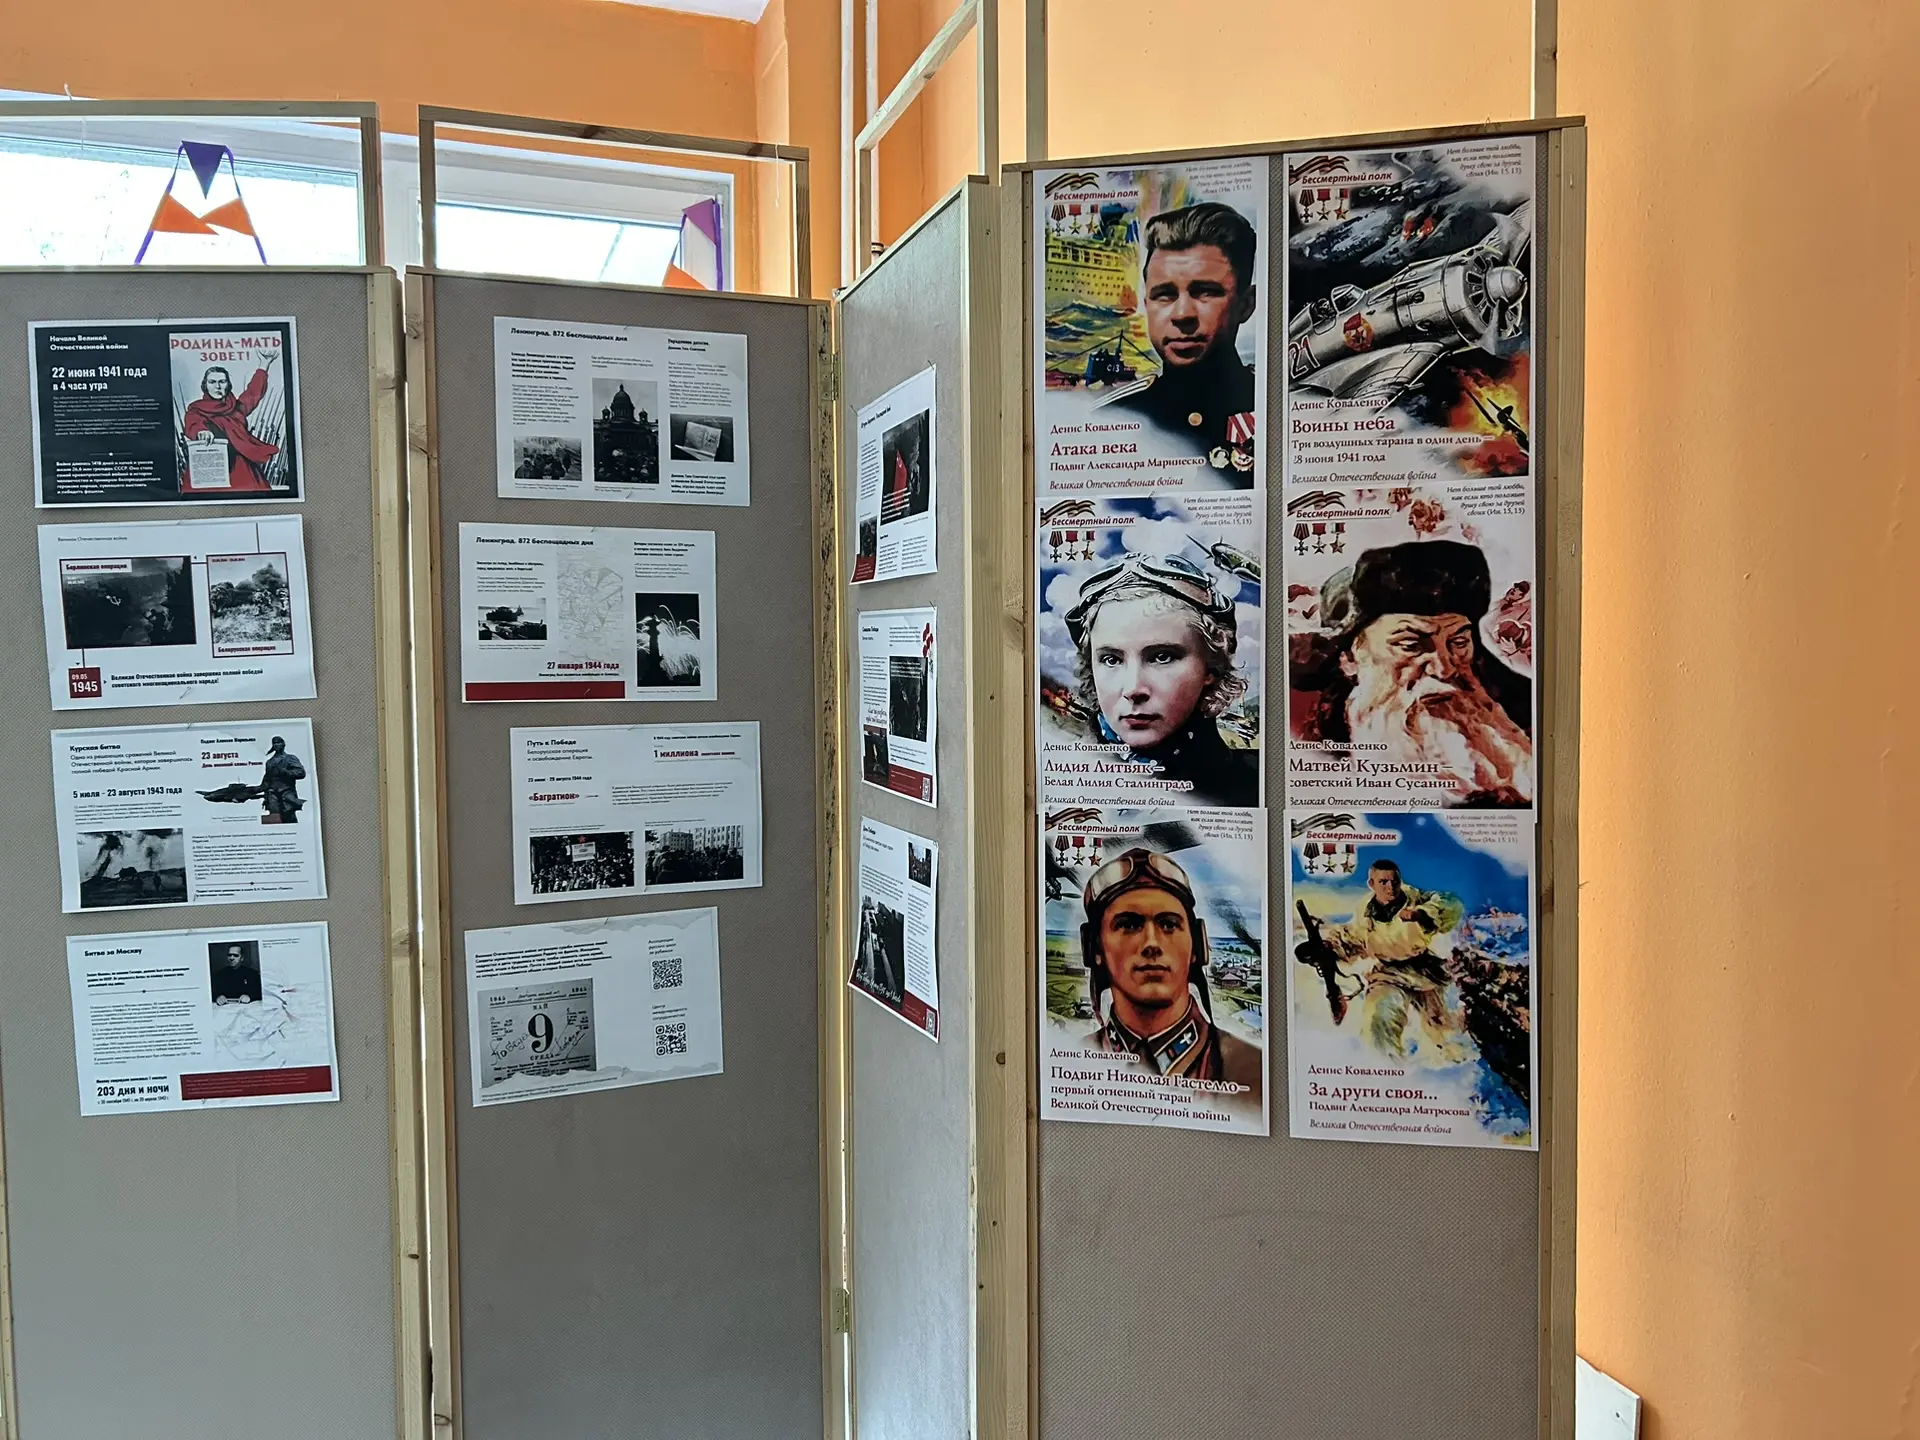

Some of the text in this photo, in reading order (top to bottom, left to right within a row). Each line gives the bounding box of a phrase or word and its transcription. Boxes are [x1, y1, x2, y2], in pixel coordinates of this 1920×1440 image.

[1302, 174, 1366, 184] Бессмертный
[1054, 192, 1115, 201] Бессмертный
[171, 337, 281, 349] РОДИНА-МАТЬ
[200, 352, 250, 361] ЗОВЕТ!
[52, 366, 147, 378] 22 июня 1941 года
[89, 382, 107, 391] утра
[1292, 399, 1388, 411] Денис Коваленко
[1050, 422, 1140, 435] Денис Коваленко
[1293, 416, 1395, 433] Воины неба
[1292, 441, 1311, 450] Три
[1314, 439, 1373, 449] воздушных
[1376, 437, 1414, 447] тарана
[1417, 438, 1423, 446] в
[1426, 436, 1453, 446] один
[1455, 434, 1482, 445] день
[1051, 443, 1137, 456] Атака века
[1305, 454, 1334, 463] июня
[1337, 453, 1359, 462] 1941
[1362, 454, 1385, 462] года
[1050, 457, 1204, 473] Подвиг Александра Маринеско
[1050, 477, 1183, 490] Великая Отечественная война
[1292, 471, 1436, 484] Великая Отечественная война
[1297, 508, 1363, 518] Бессмертный
[1051, 517, 1134, 527] Бессмертный полк
[73, 681, 97, 692] 1945
[1044, 743, 1129, 752] Денис Коваленко
[1324, 741, 1387, 751] Коваленко
[1045, 759, 1089, 773] Лидия
[1290, 759, 1350, 772] Матвей
[1357, 759, 1438, 775] Кузьмин
[1045, 777, 1192, 790] Белая Лилия Сталинграда
[1356, 778, 1391, 788] Иван
[1395, 778, 1456, 789] Сусанин
[529, 793, 579, 802] «Багратион»
[1045, 795, 1175, 806] Великая Отечественная война
[1328, 797, 1407, 806] Отечественная
[1409, 797, 1439, 806] война
[1058, 823, 1140, 834] Бессмертный полк
[1306, 831, 1397, 841] Бессмертный полк
[528, 1013, 553, 1053] 9
[1050, 1048, 1139, 1061] Денис Коваленко
[1051, 1066, 1103, 1082] Подвиг
[1108, 1069, 1170, 1085] Николая
[1308, 1064, 1404, 1076] Денис Коваленко
[97, 1086, 115, 1096] 203
[118, 1087, 135, 1096] дня
[147, 1085, 169, 1093] ночи
[1051, 1085, 1191, 1104] первый огненный таран
[1309, 1082, 1327, 1096] За
[1332, 1085, 1380, 1101] други
[1051, 1098, 1231, 1122] Великой Отечественной войны
[1309, 1102, 1470, 1117] Подвиг Александра Матросова
[1310, 1119, 1452, 1134] Великая Отечественная война
